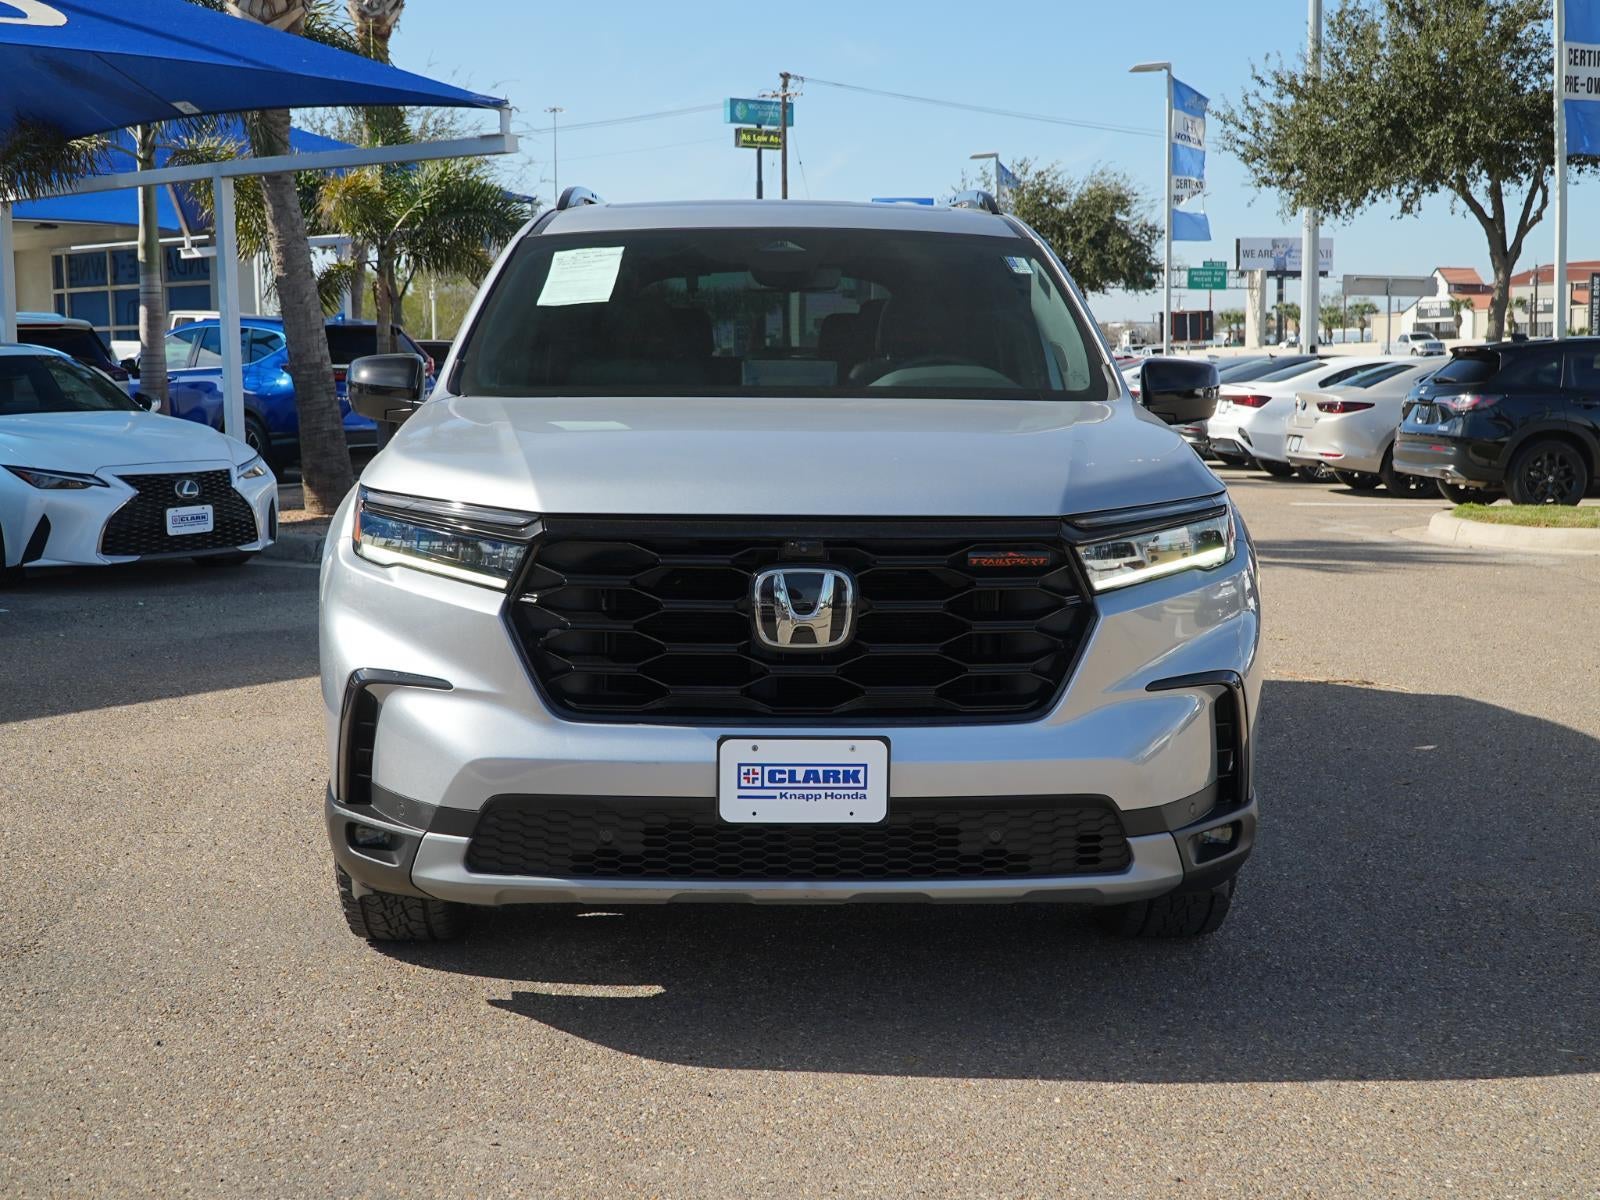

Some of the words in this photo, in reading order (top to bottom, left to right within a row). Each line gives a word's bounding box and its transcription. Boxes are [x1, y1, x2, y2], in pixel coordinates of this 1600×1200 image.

[753, 134, 768, 142] Low
[1174, 131, 1202, 146] HONDA
[1242, 250, 1255, 259] WE
[1257, 249, 1274, 258] ARE
[768, 769, 862, 784] CLARK
[779, 791, 822, 802] Knapp
[824, 791, 867, 801] Honda
